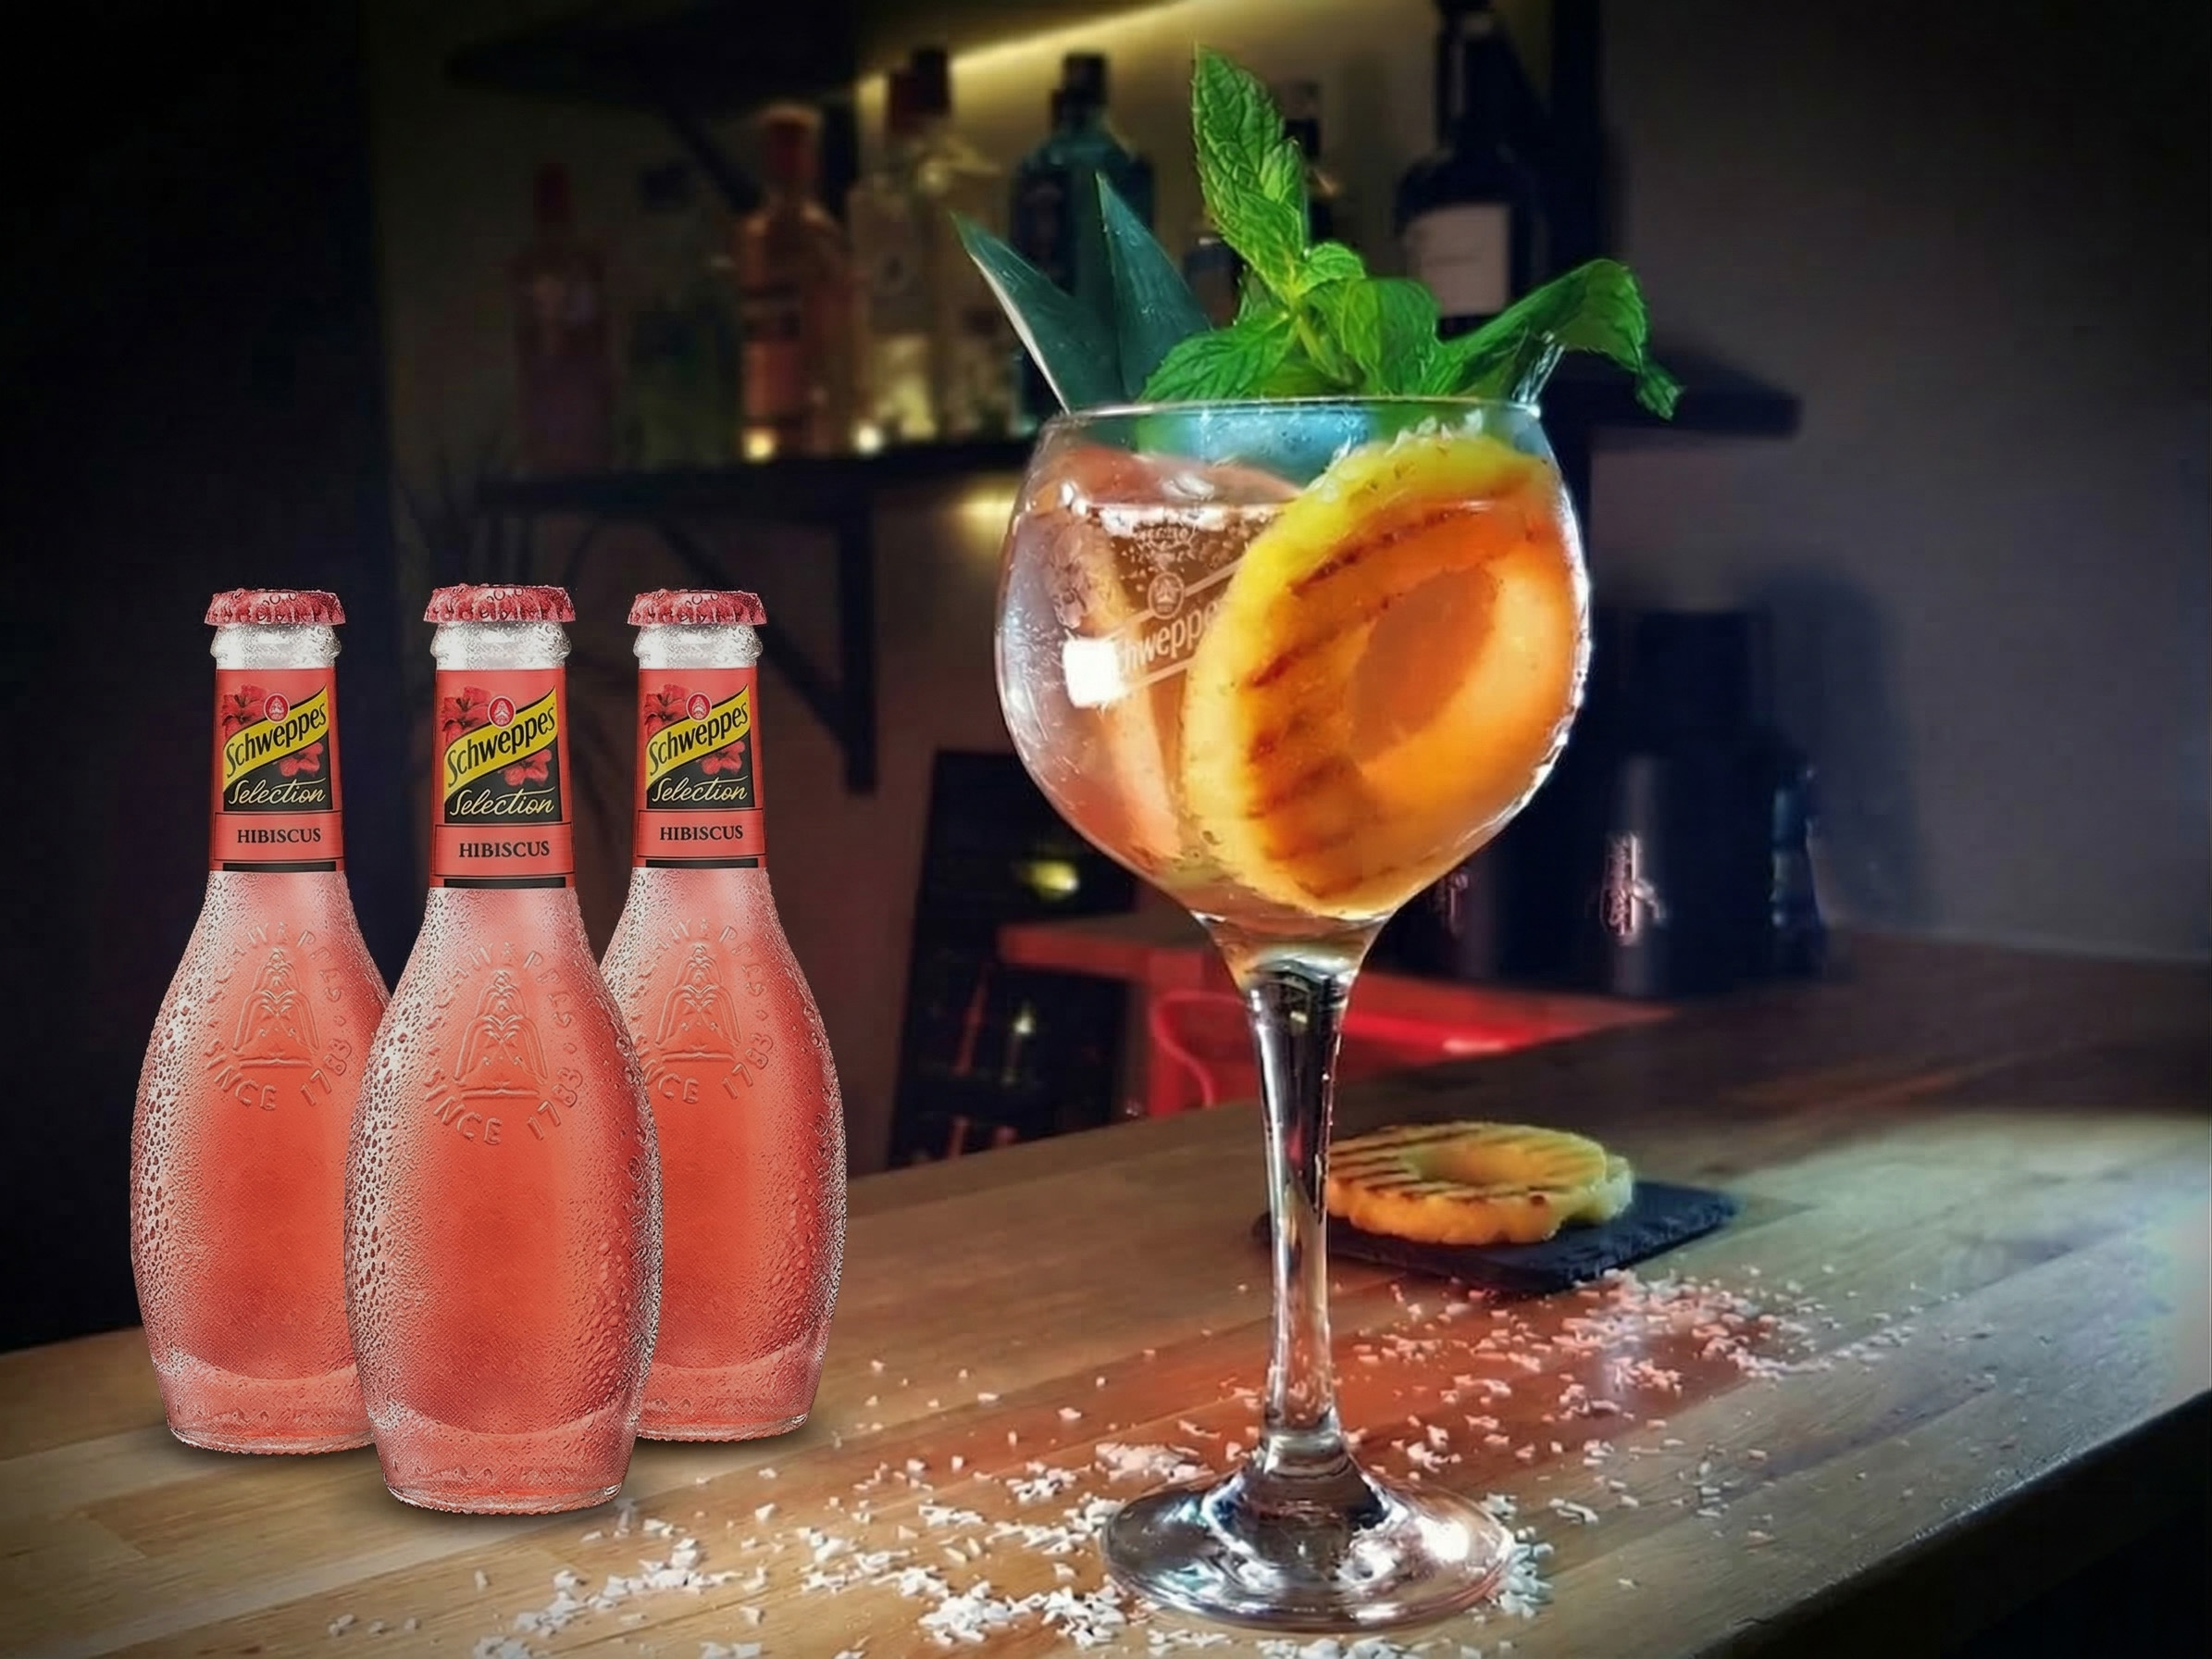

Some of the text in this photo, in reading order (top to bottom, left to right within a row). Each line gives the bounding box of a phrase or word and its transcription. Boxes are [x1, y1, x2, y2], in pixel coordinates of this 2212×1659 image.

[1122, 600, 1219, 675] hweppe
[226, 702, 327, 779] Schweppes
[446, 706, 555, 788] Schweppes
[649, 701, 749, 777] Schweppes
[228, 777, 327, 805] Selection
[449, 786, 556, 816] Selection
[651, 775, 749, 803] Selection
[237, 827, 321, 843] HIBISCUS
[458, 840, 551, 857] HIBISCUS
[659, 824, 744, 841] HIBISCUS
[204, 1038, 278, 1111] SINCE
[423, 1066, 503, 1145] SINCE
